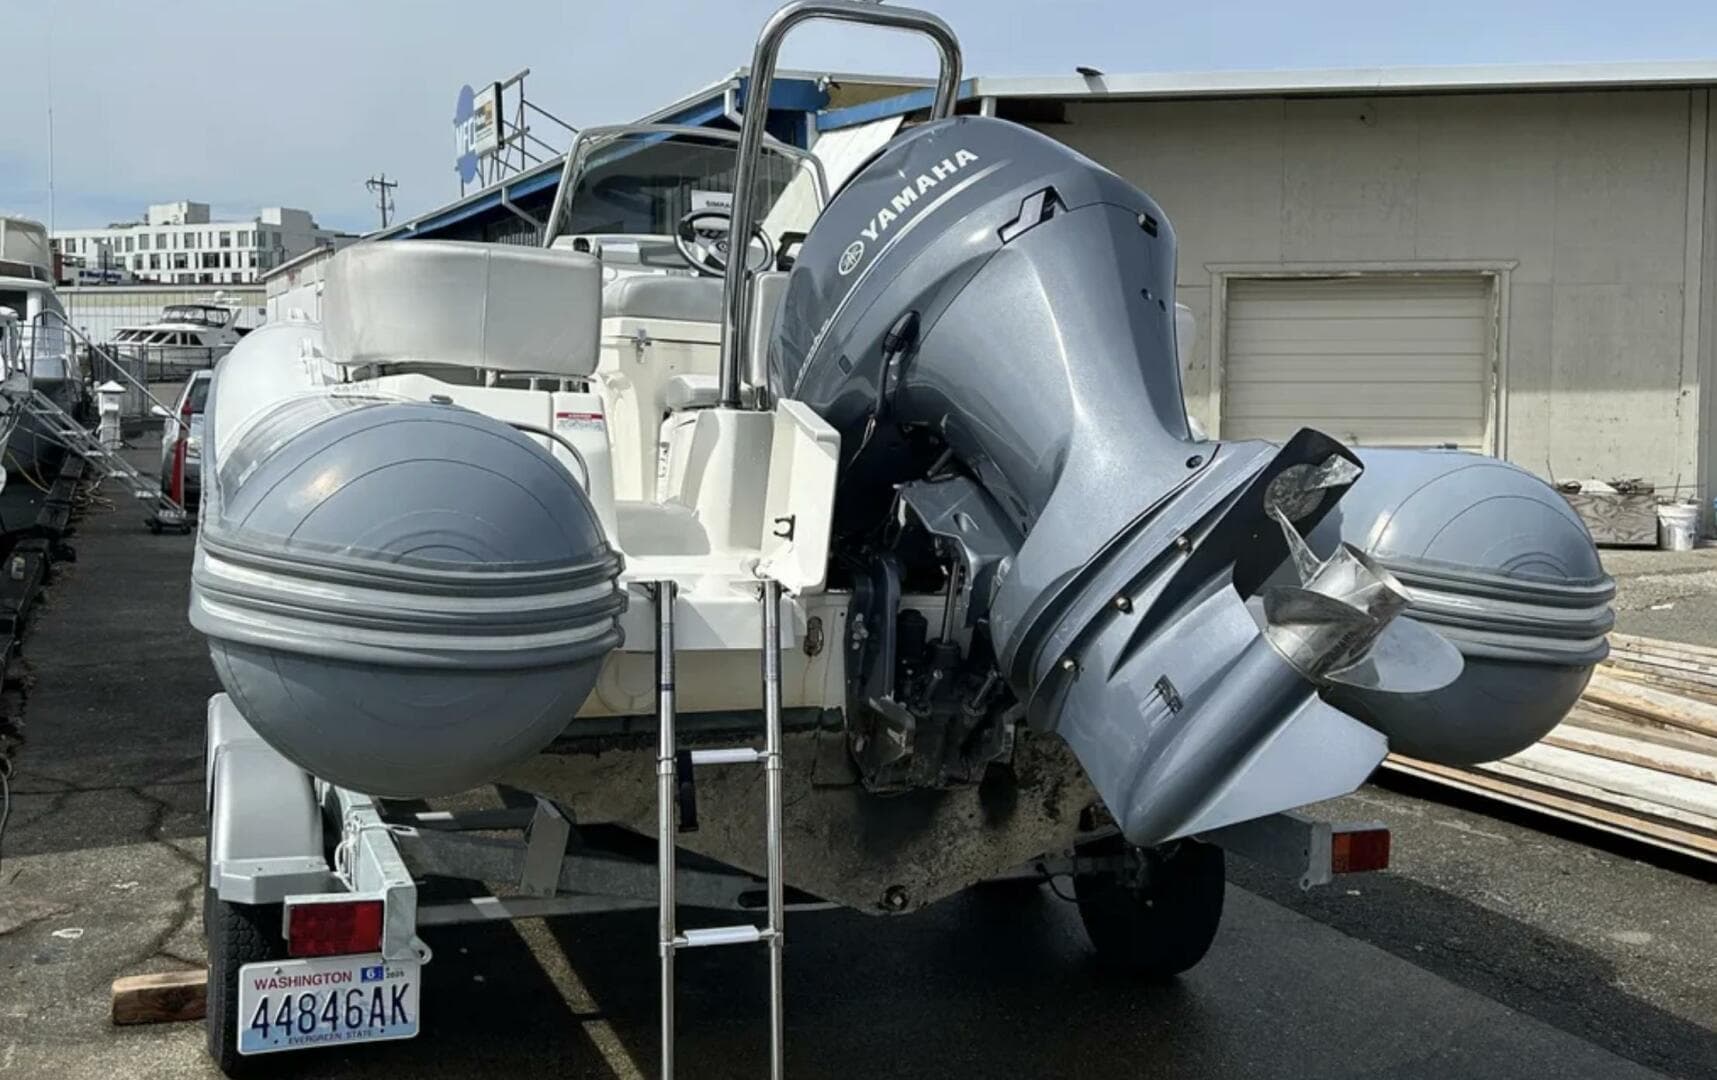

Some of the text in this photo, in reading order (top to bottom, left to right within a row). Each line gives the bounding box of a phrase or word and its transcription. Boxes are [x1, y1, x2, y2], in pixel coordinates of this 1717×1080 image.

[861, 149, 978, 241] YAMAHA
[254, 970, 353, 991] WASHINGTON
[251, 983, 410, 1040] 44846AK
[346, 1029, 372, 1040] STATE
